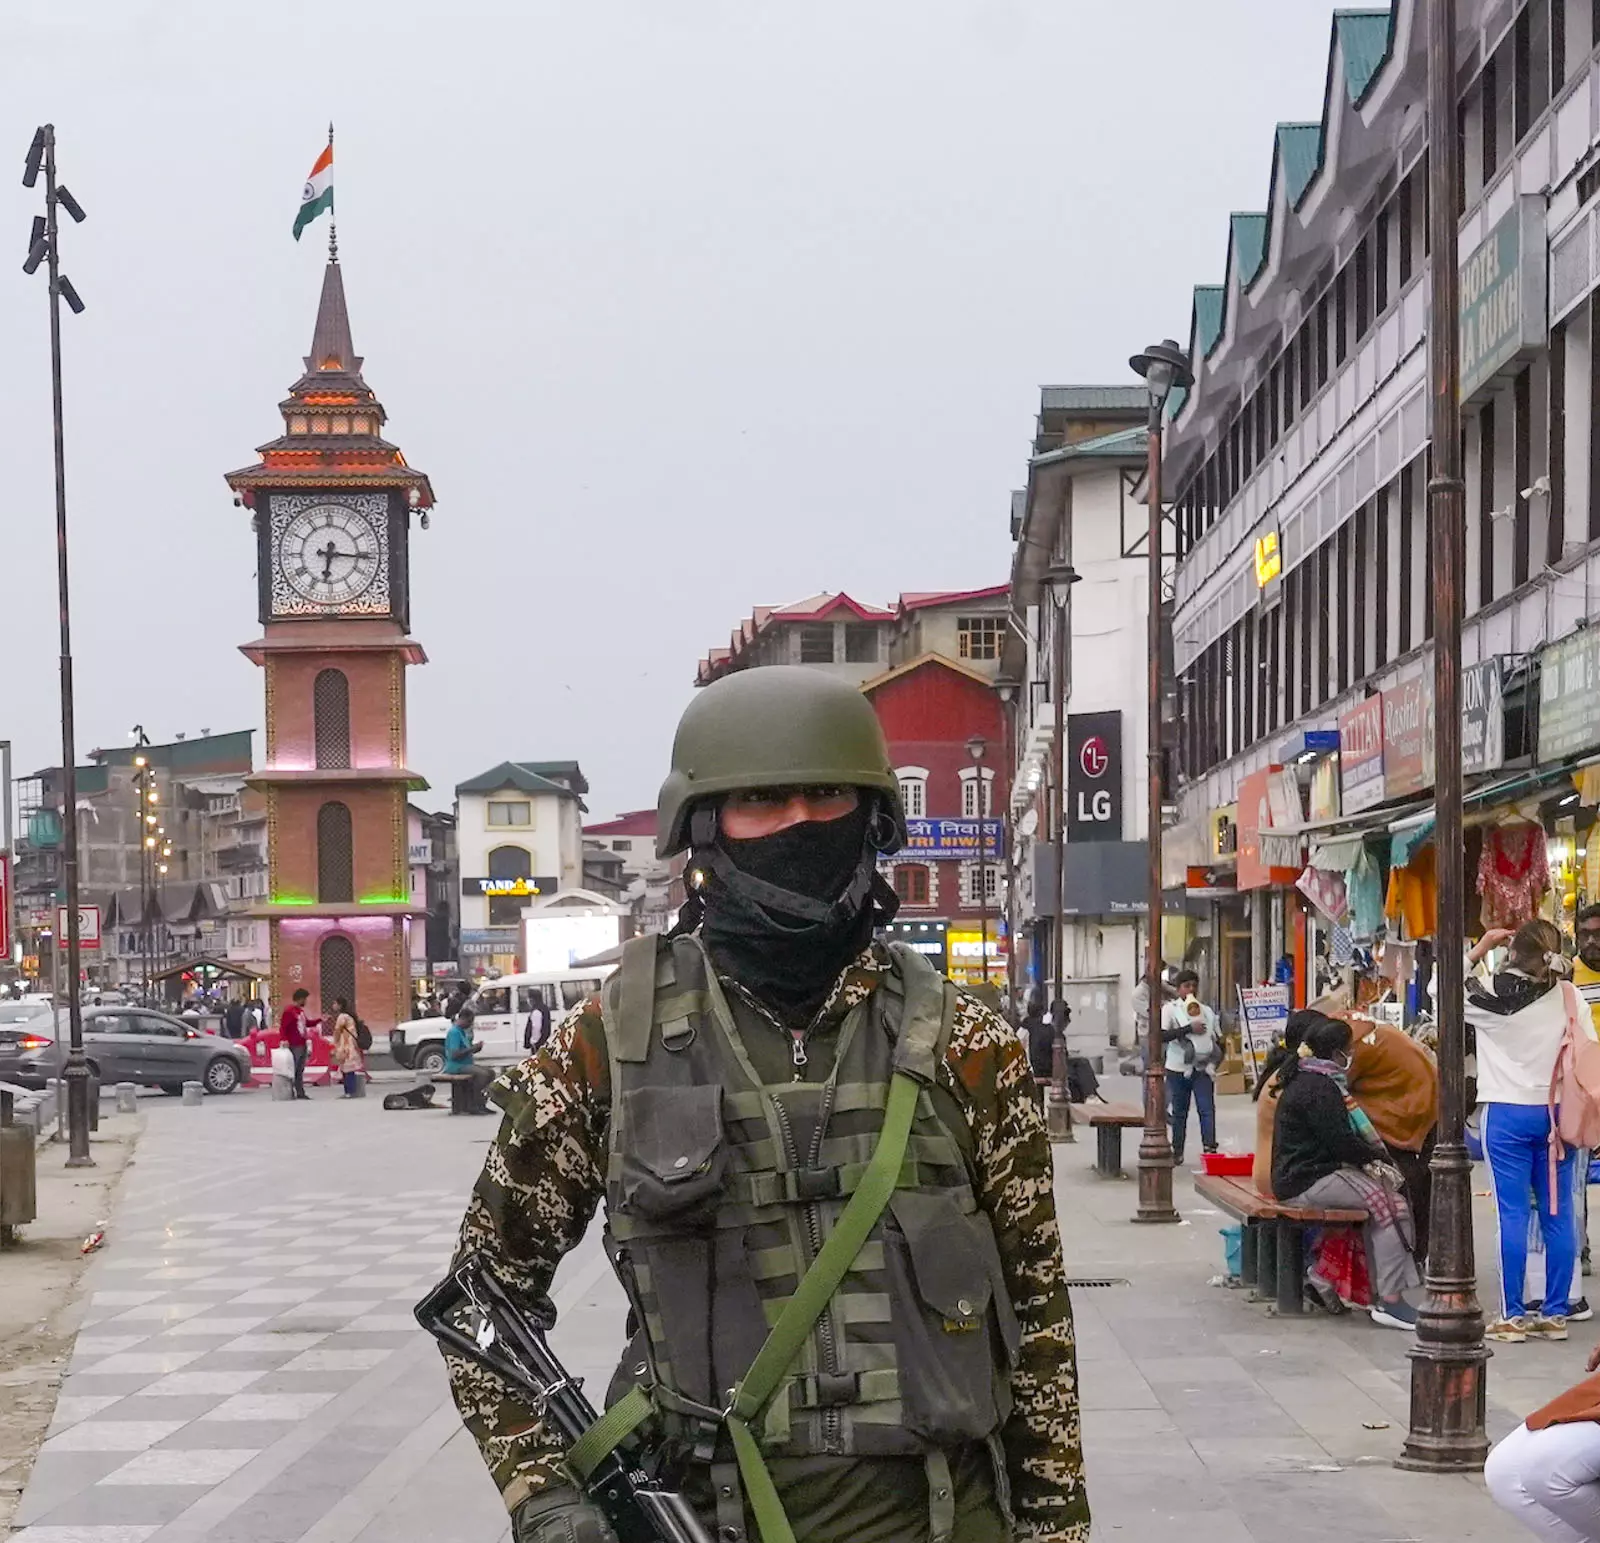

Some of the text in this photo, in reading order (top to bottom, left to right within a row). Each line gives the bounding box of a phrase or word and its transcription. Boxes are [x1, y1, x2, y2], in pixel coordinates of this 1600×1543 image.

[1461, 234, 1499, 315] HOTEL
[1479, 267, 1518, 358] RUKH
[1077, 789, 1112, 822] LG
[463, 943, 516, 953] CRAFT HIVE
[1254, 988, 1286, 999] Xiaomi
